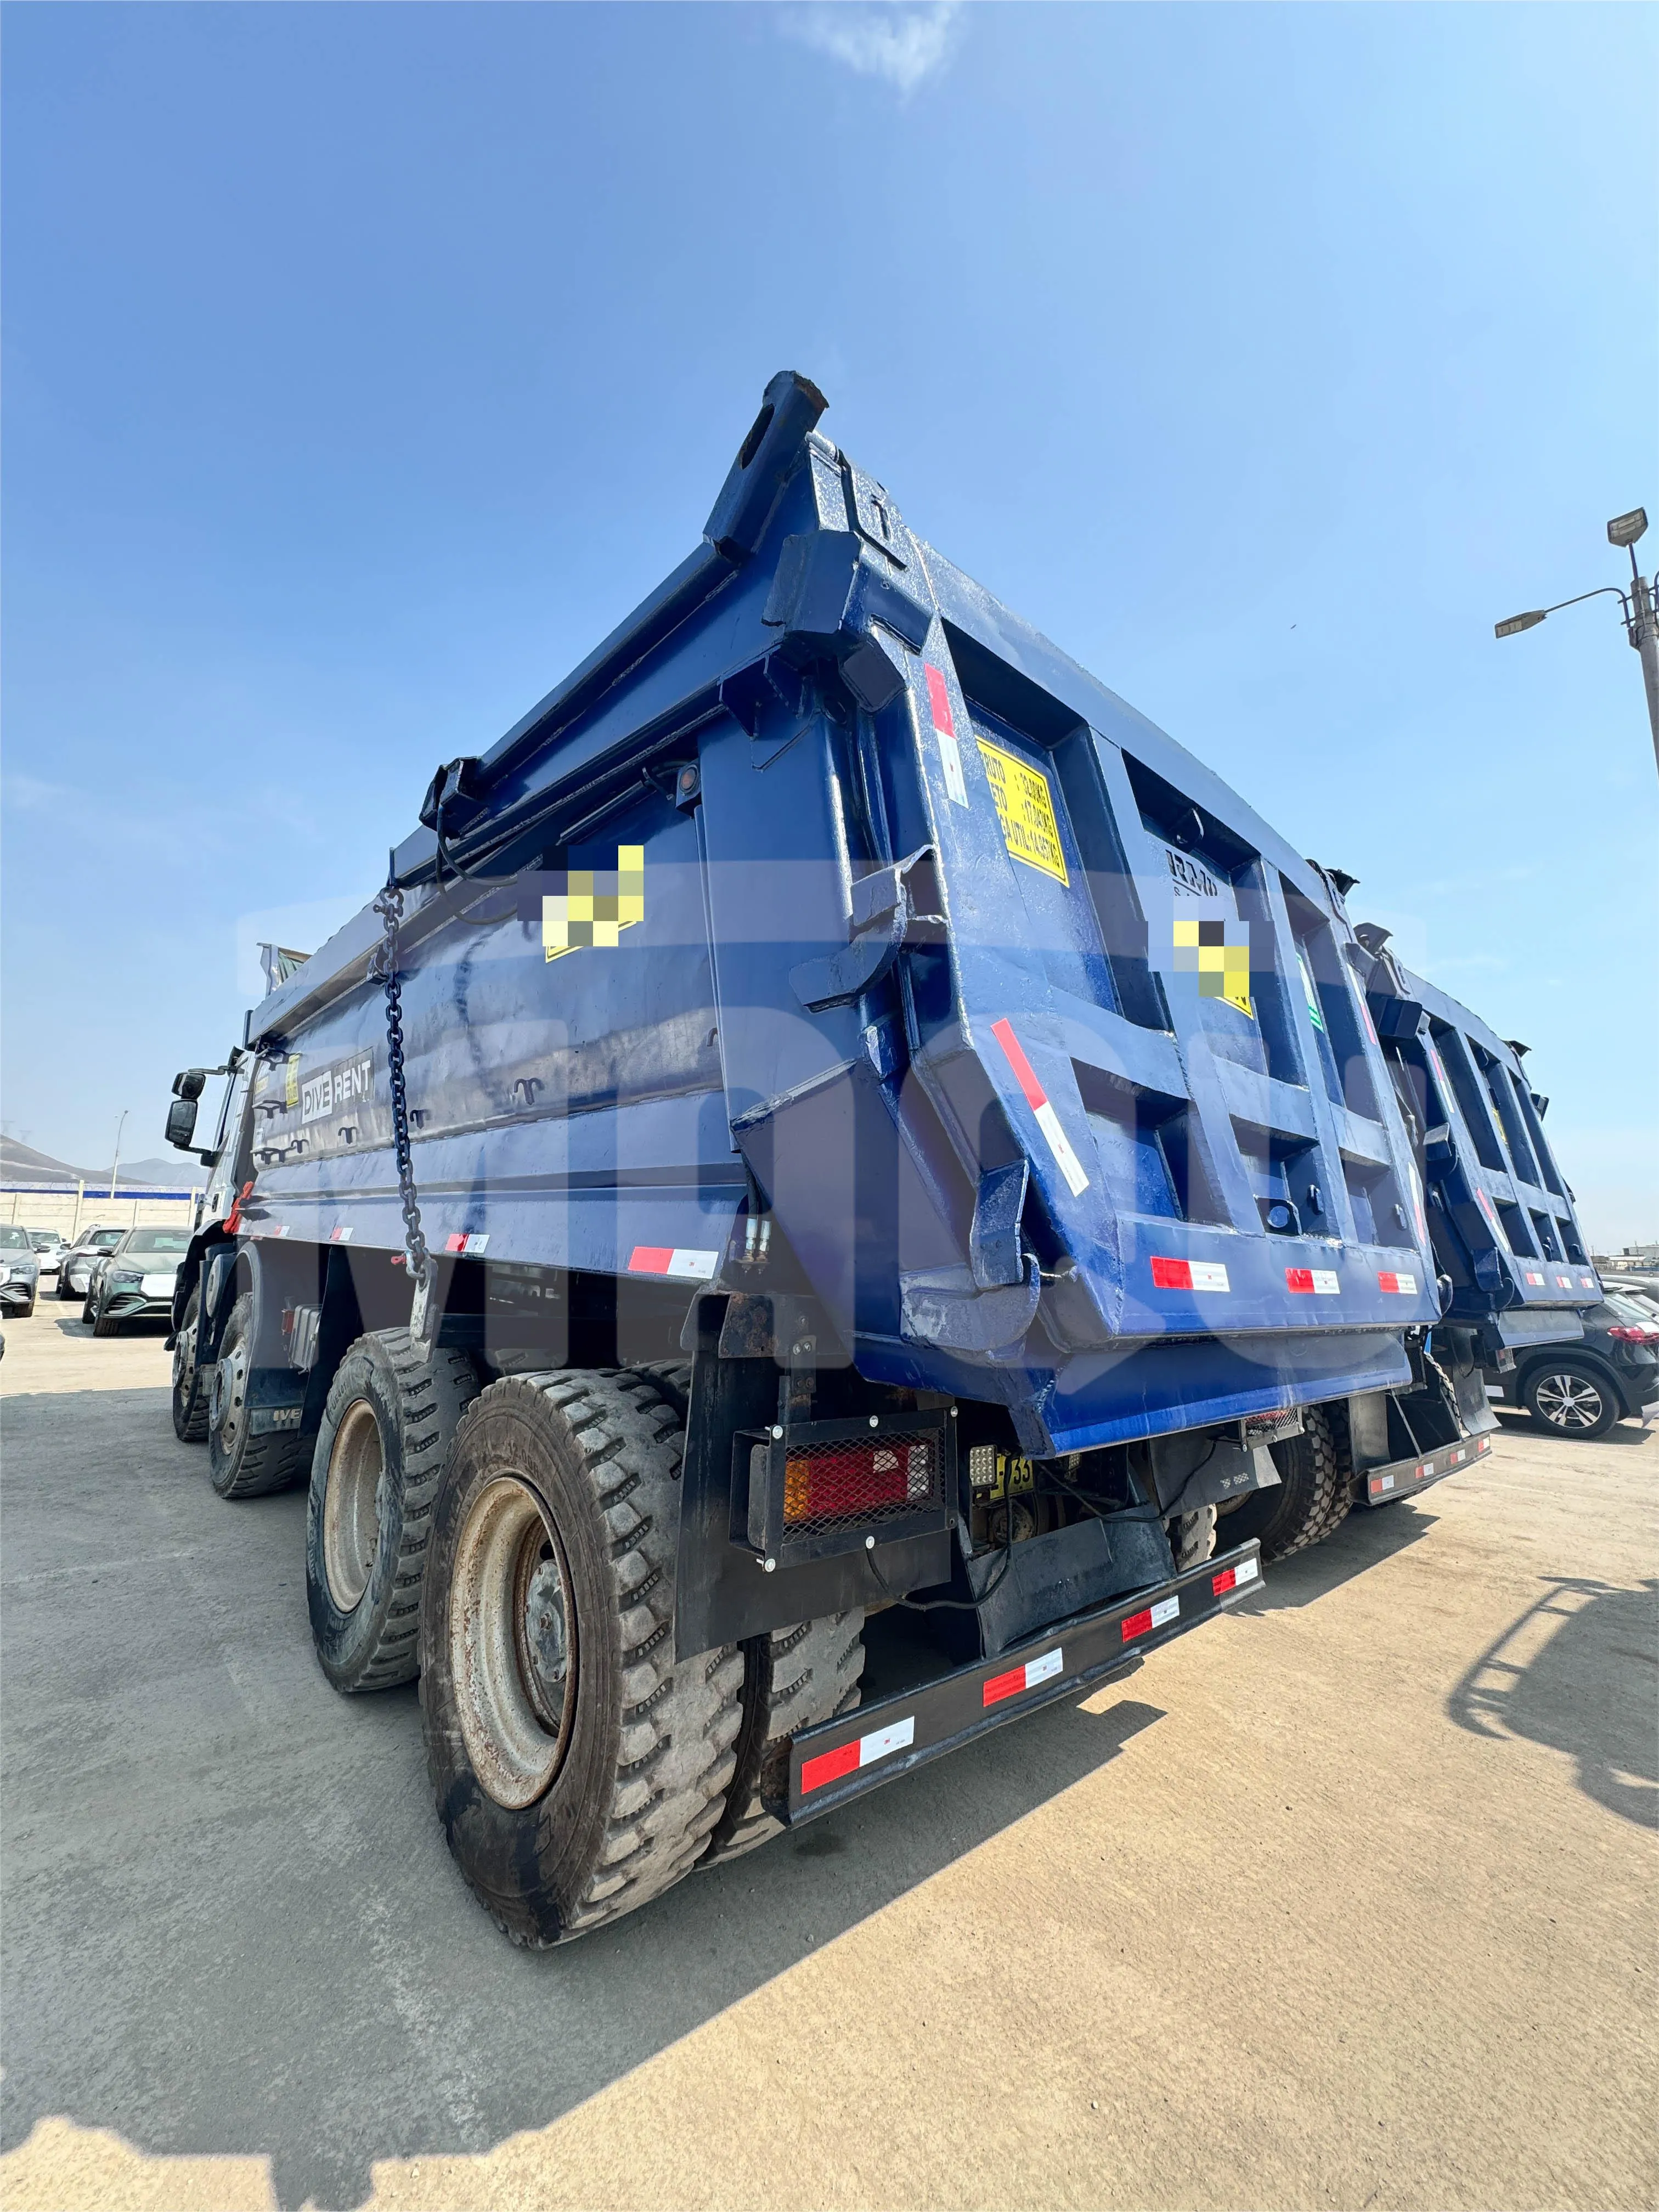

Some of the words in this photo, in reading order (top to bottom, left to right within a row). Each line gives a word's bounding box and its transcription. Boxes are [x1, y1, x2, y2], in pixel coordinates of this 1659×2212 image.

[982, 752, 1006, 785] RUTO
[334, 1059, 371, 1104] RENT
[273, 1408, 301, 1421] IVE
